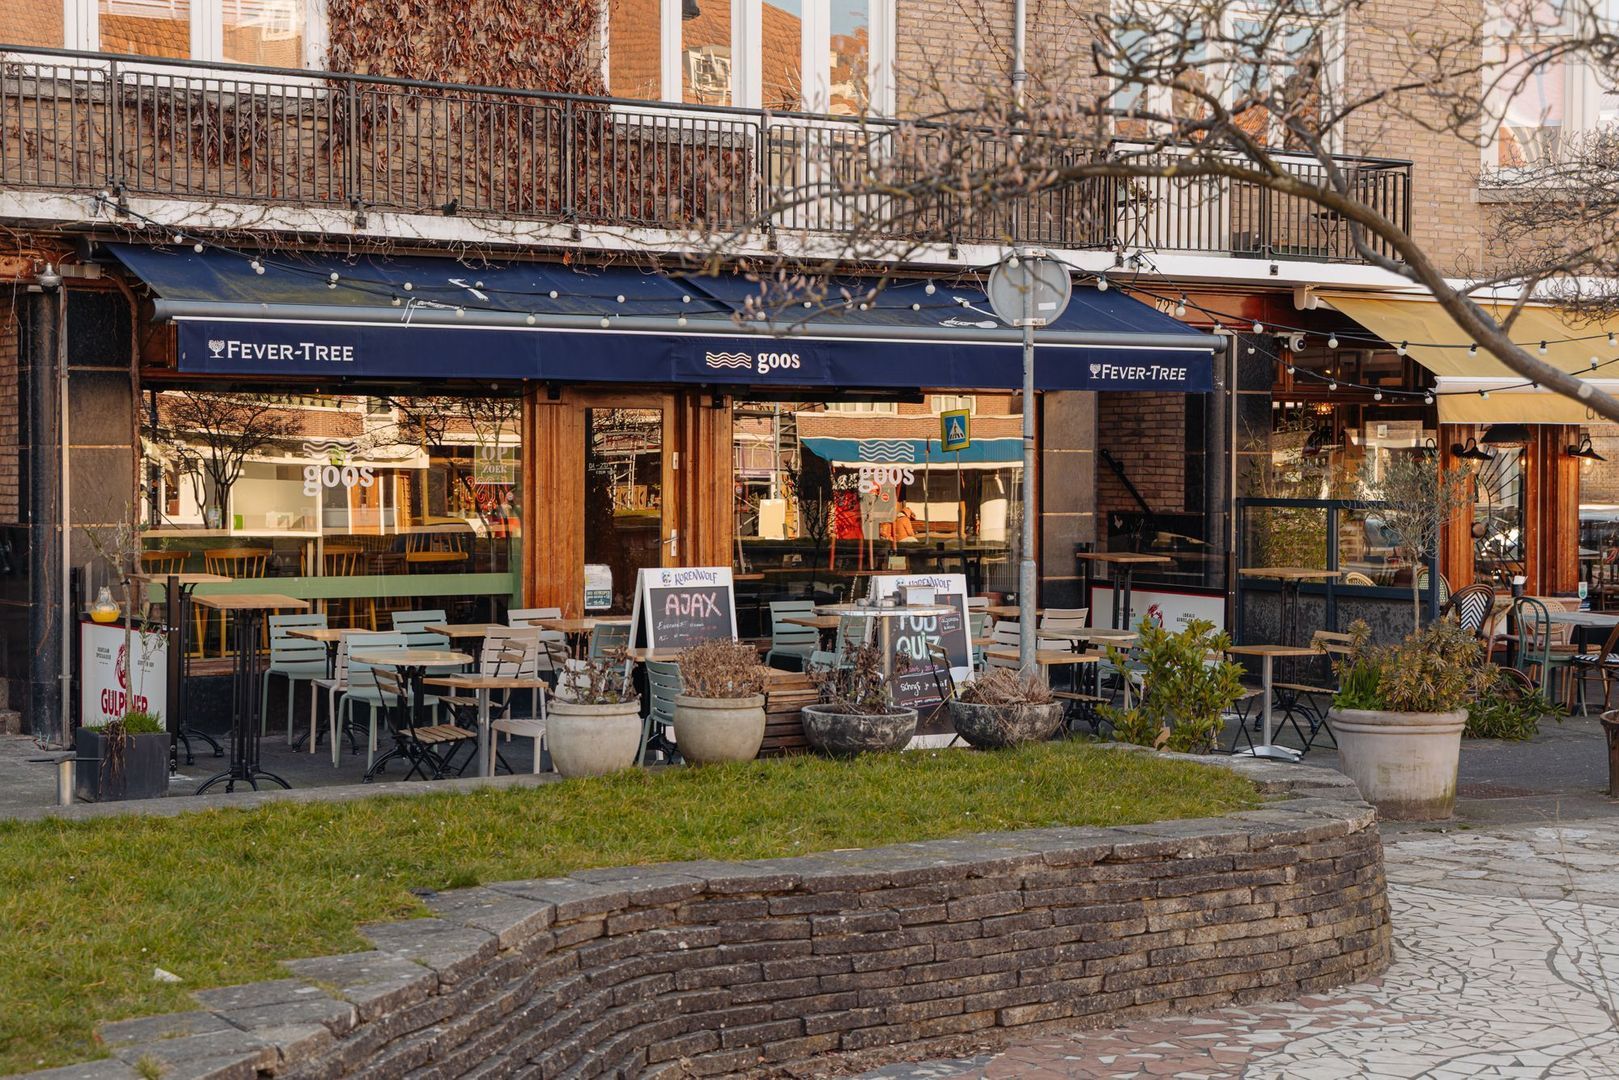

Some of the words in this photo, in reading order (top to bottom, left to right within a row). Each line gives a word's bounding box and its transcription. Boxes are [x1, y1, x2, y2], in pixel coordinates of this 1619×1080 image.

[227, 340, 354, 361] FEVER-TREE
[757, 353, 800, 374] goos
[1101, 364, 1187, 380] FEVER-TREE
[481, 446, 507, 461] OP
[483, 464, 507, 473] ZOEK
[303, 465, 374, 496] goos
[859, 466, 915, 493] goos
[674, 569, 717, 585] KORENWOLF
[665, 592, 722, 618] AJAX
